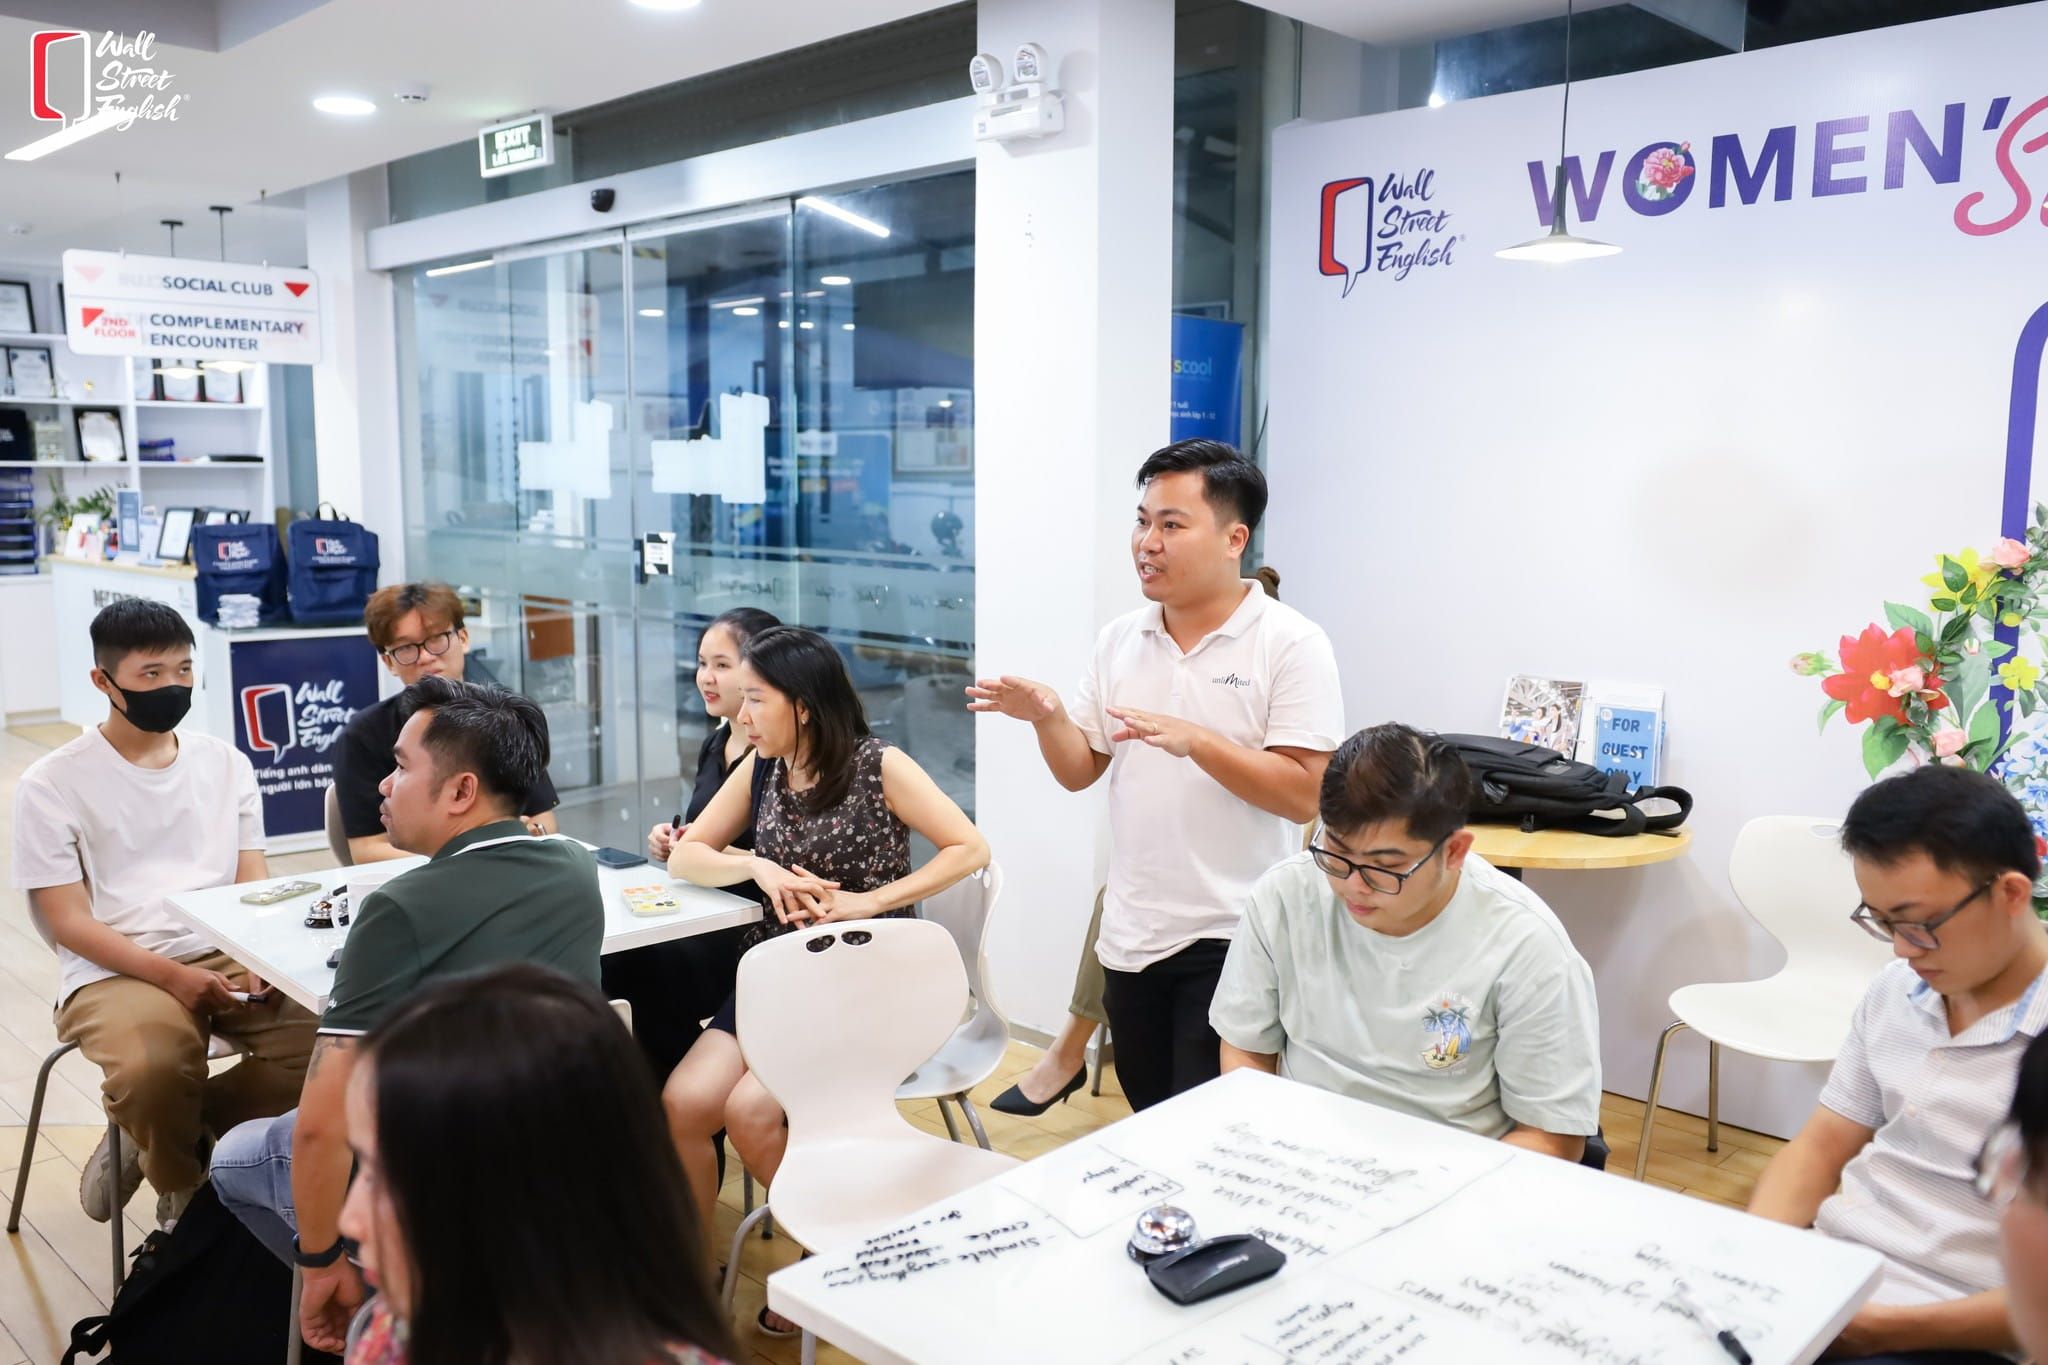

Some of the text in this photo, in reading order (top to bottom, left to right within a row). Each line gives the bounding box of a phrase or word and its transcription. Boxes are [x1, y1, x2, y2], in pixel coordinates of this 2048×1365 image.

[495, 125, 531, 150] EXIT
[1378, 168, 1435, 203] Wall
[1377, 205, 1454, 239] Street
[1376, 236, 1457, 281] English
[162, 275, 227, 293] SOCIAL
[231, 281, 274, 297] CLUB
[101, 316, 129, 327] 2ND
[150, 313, 305, 334] COMPLEMENTARY
[94, 327, 136, 339] FLOOR
[150, 332, 258, 351] ENCOUNTER
[1173, 357, 1212, 376] scool
[295, 680, 344, 704] Wall
[1612, 718, 1640, 733] FOR
[298, 725, 344, 753] Engl
[1602, 742, 1648, 760] GUEST
[287, 764, 309, 777] anh
[1606, 767, 1642, 784] OY
